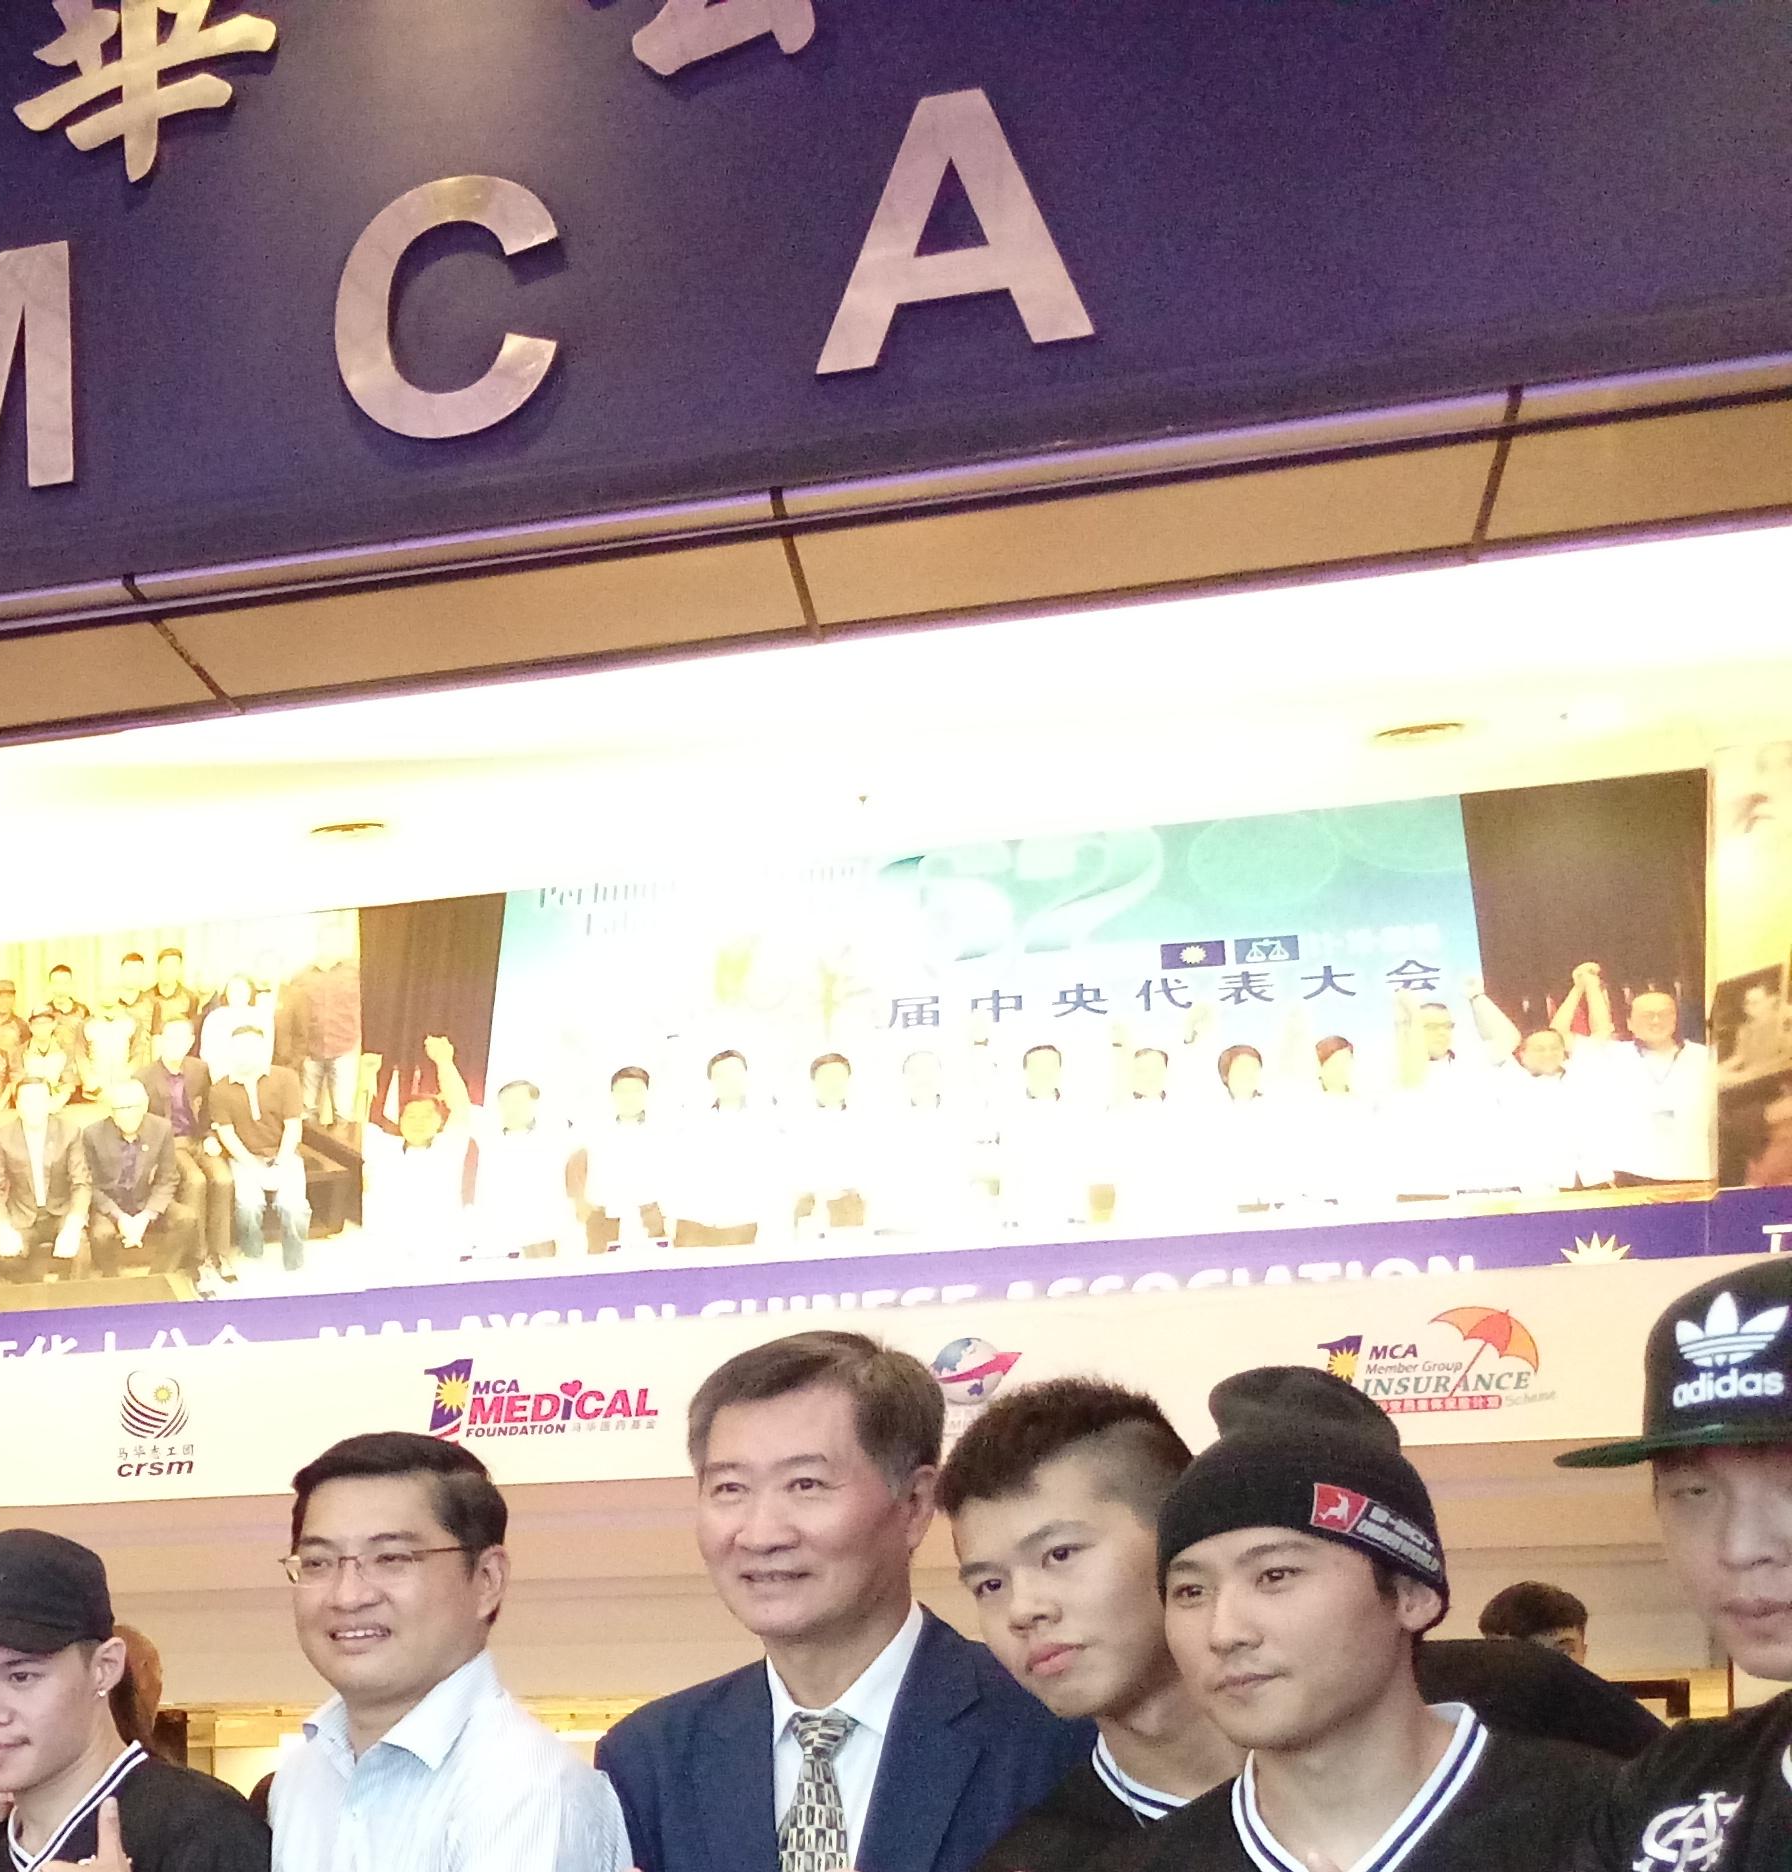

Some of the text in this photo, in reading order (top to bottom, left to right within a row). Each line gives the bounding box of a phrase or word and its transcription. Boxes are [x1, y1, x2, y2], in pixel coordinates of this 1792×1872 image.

[886, 959, 1441, 1030] 届中央代表大会
[1369, 1343, 1418, 1361] MCA
[1365, 1361, 1463, 1375] Member Group
[472, 1379, 520, 1395] MCA
[1363, 1371, 1531, 1397] INSURANCE
[1672, 1367, 1785, 1409] adidas
[465, 1423, 566, 1438] FOUNDATION
[117, 1460, 194, 1477] crsm
